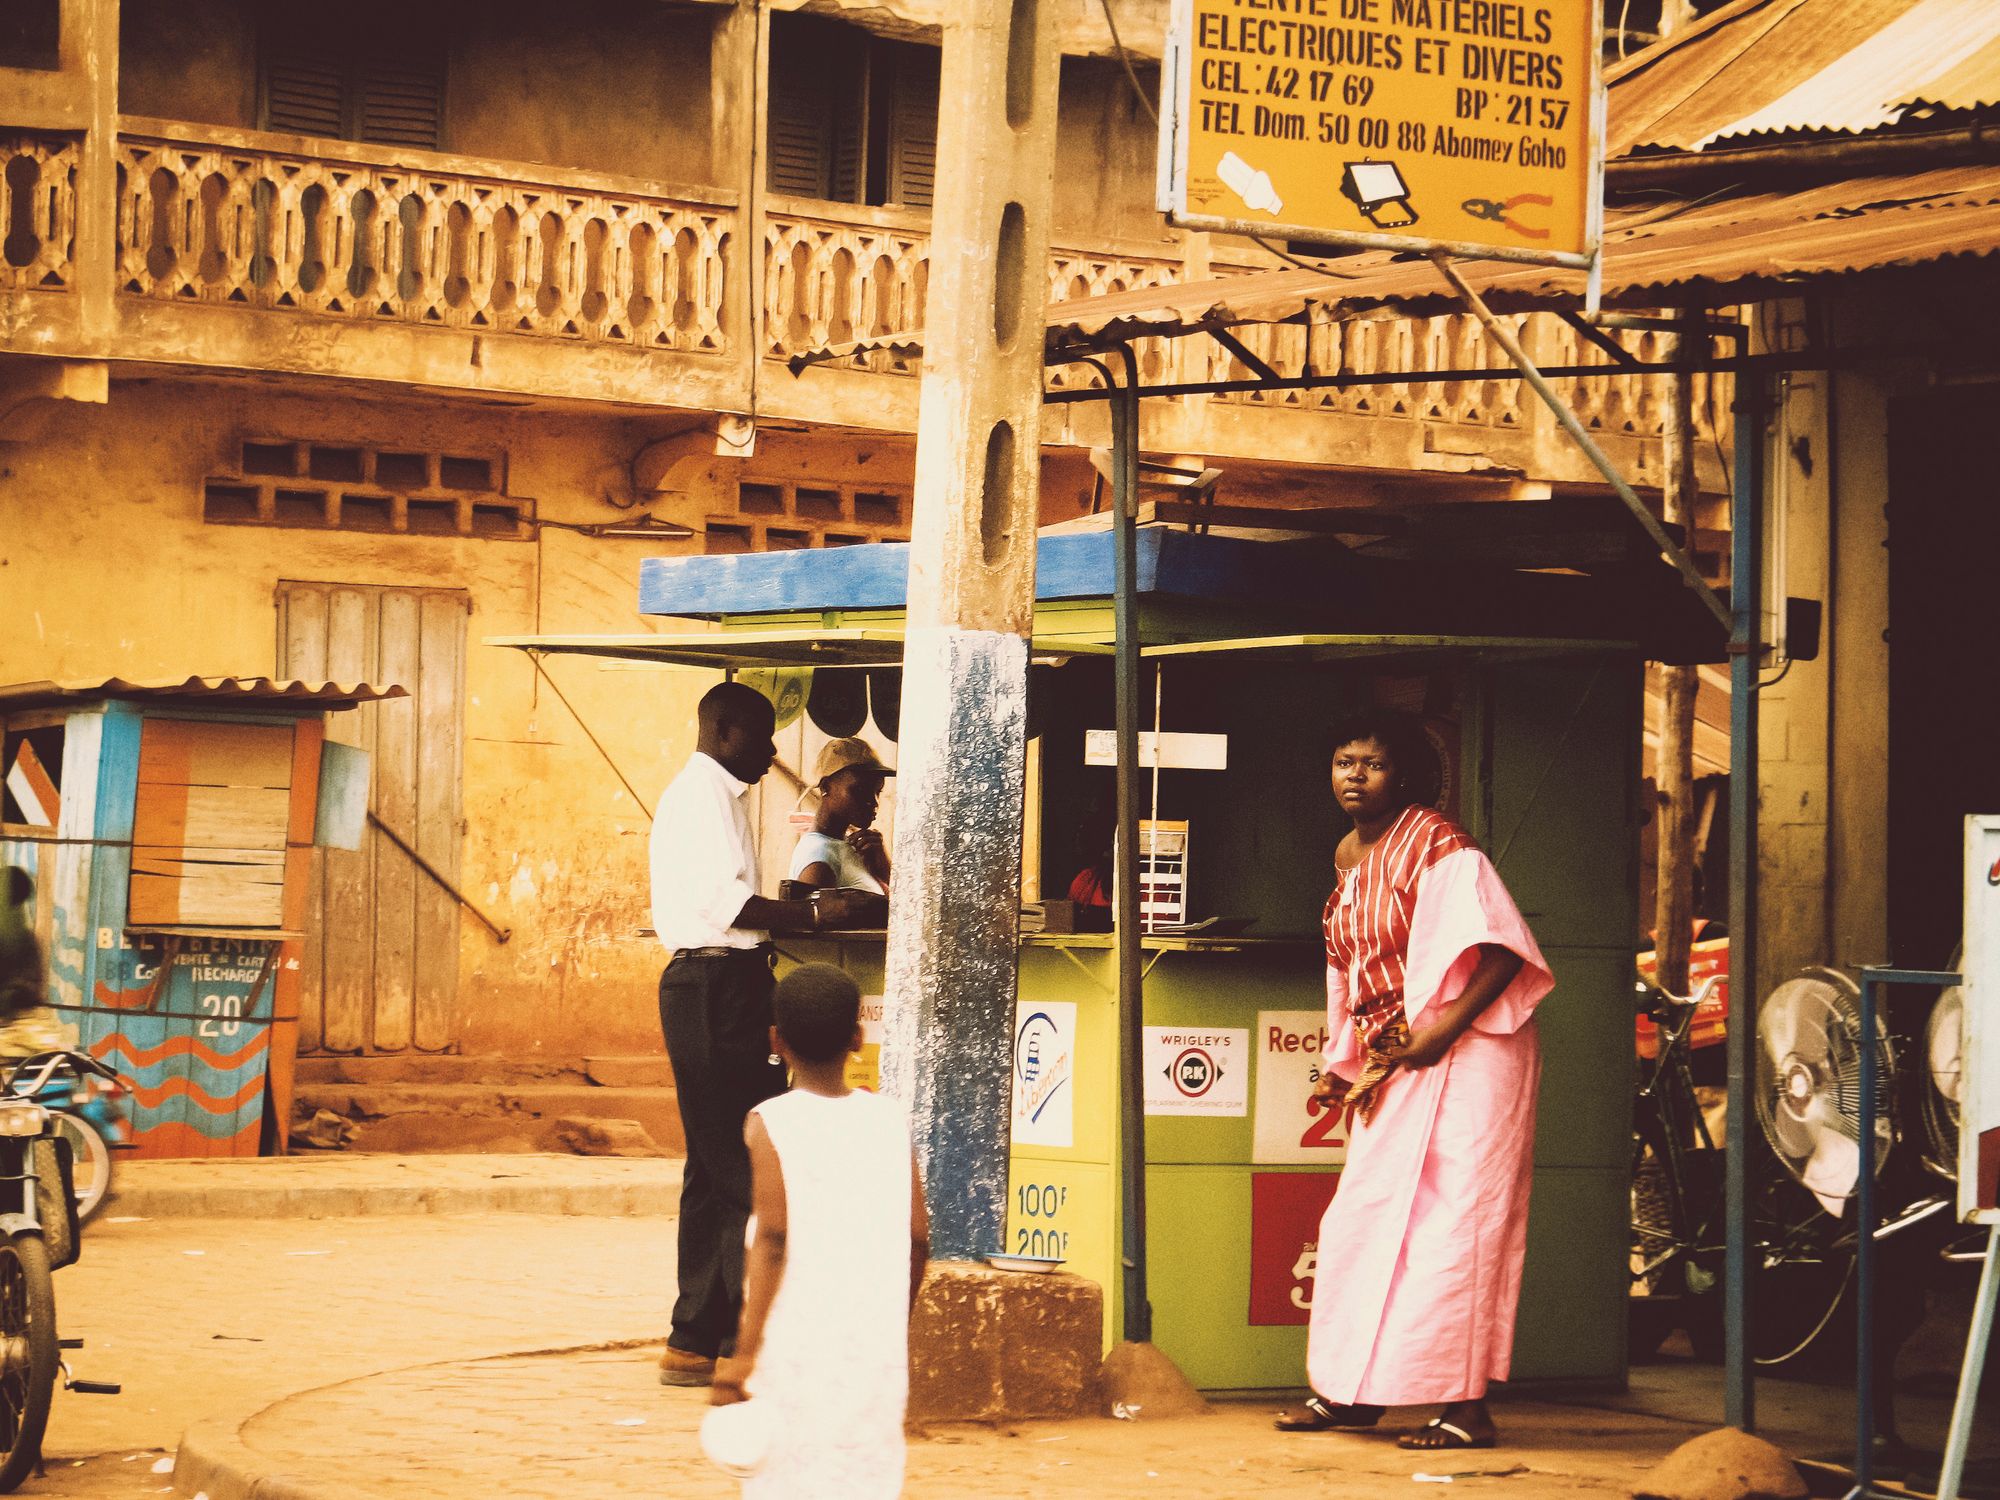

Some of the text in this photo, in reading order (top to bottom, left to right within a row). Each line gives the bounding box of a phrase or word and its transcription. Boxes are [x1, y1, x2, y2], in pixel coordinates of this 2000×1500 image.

[1392, 0, 1552, 44] MATERIELS
[1199, 12, 1563, 90] ELECTRIQUES ET DIVERS
[1309, 70, 1334, 102] 17
[1343, 74, 1374, 107] 69
[1199, 99, 1566, 169] TEL Dom. 50 00 88 Abomey Goho
[1160, 1035, 1231, 1047] WRIGLEY'S
[1269, 1026, 1330, 1053] Rech
